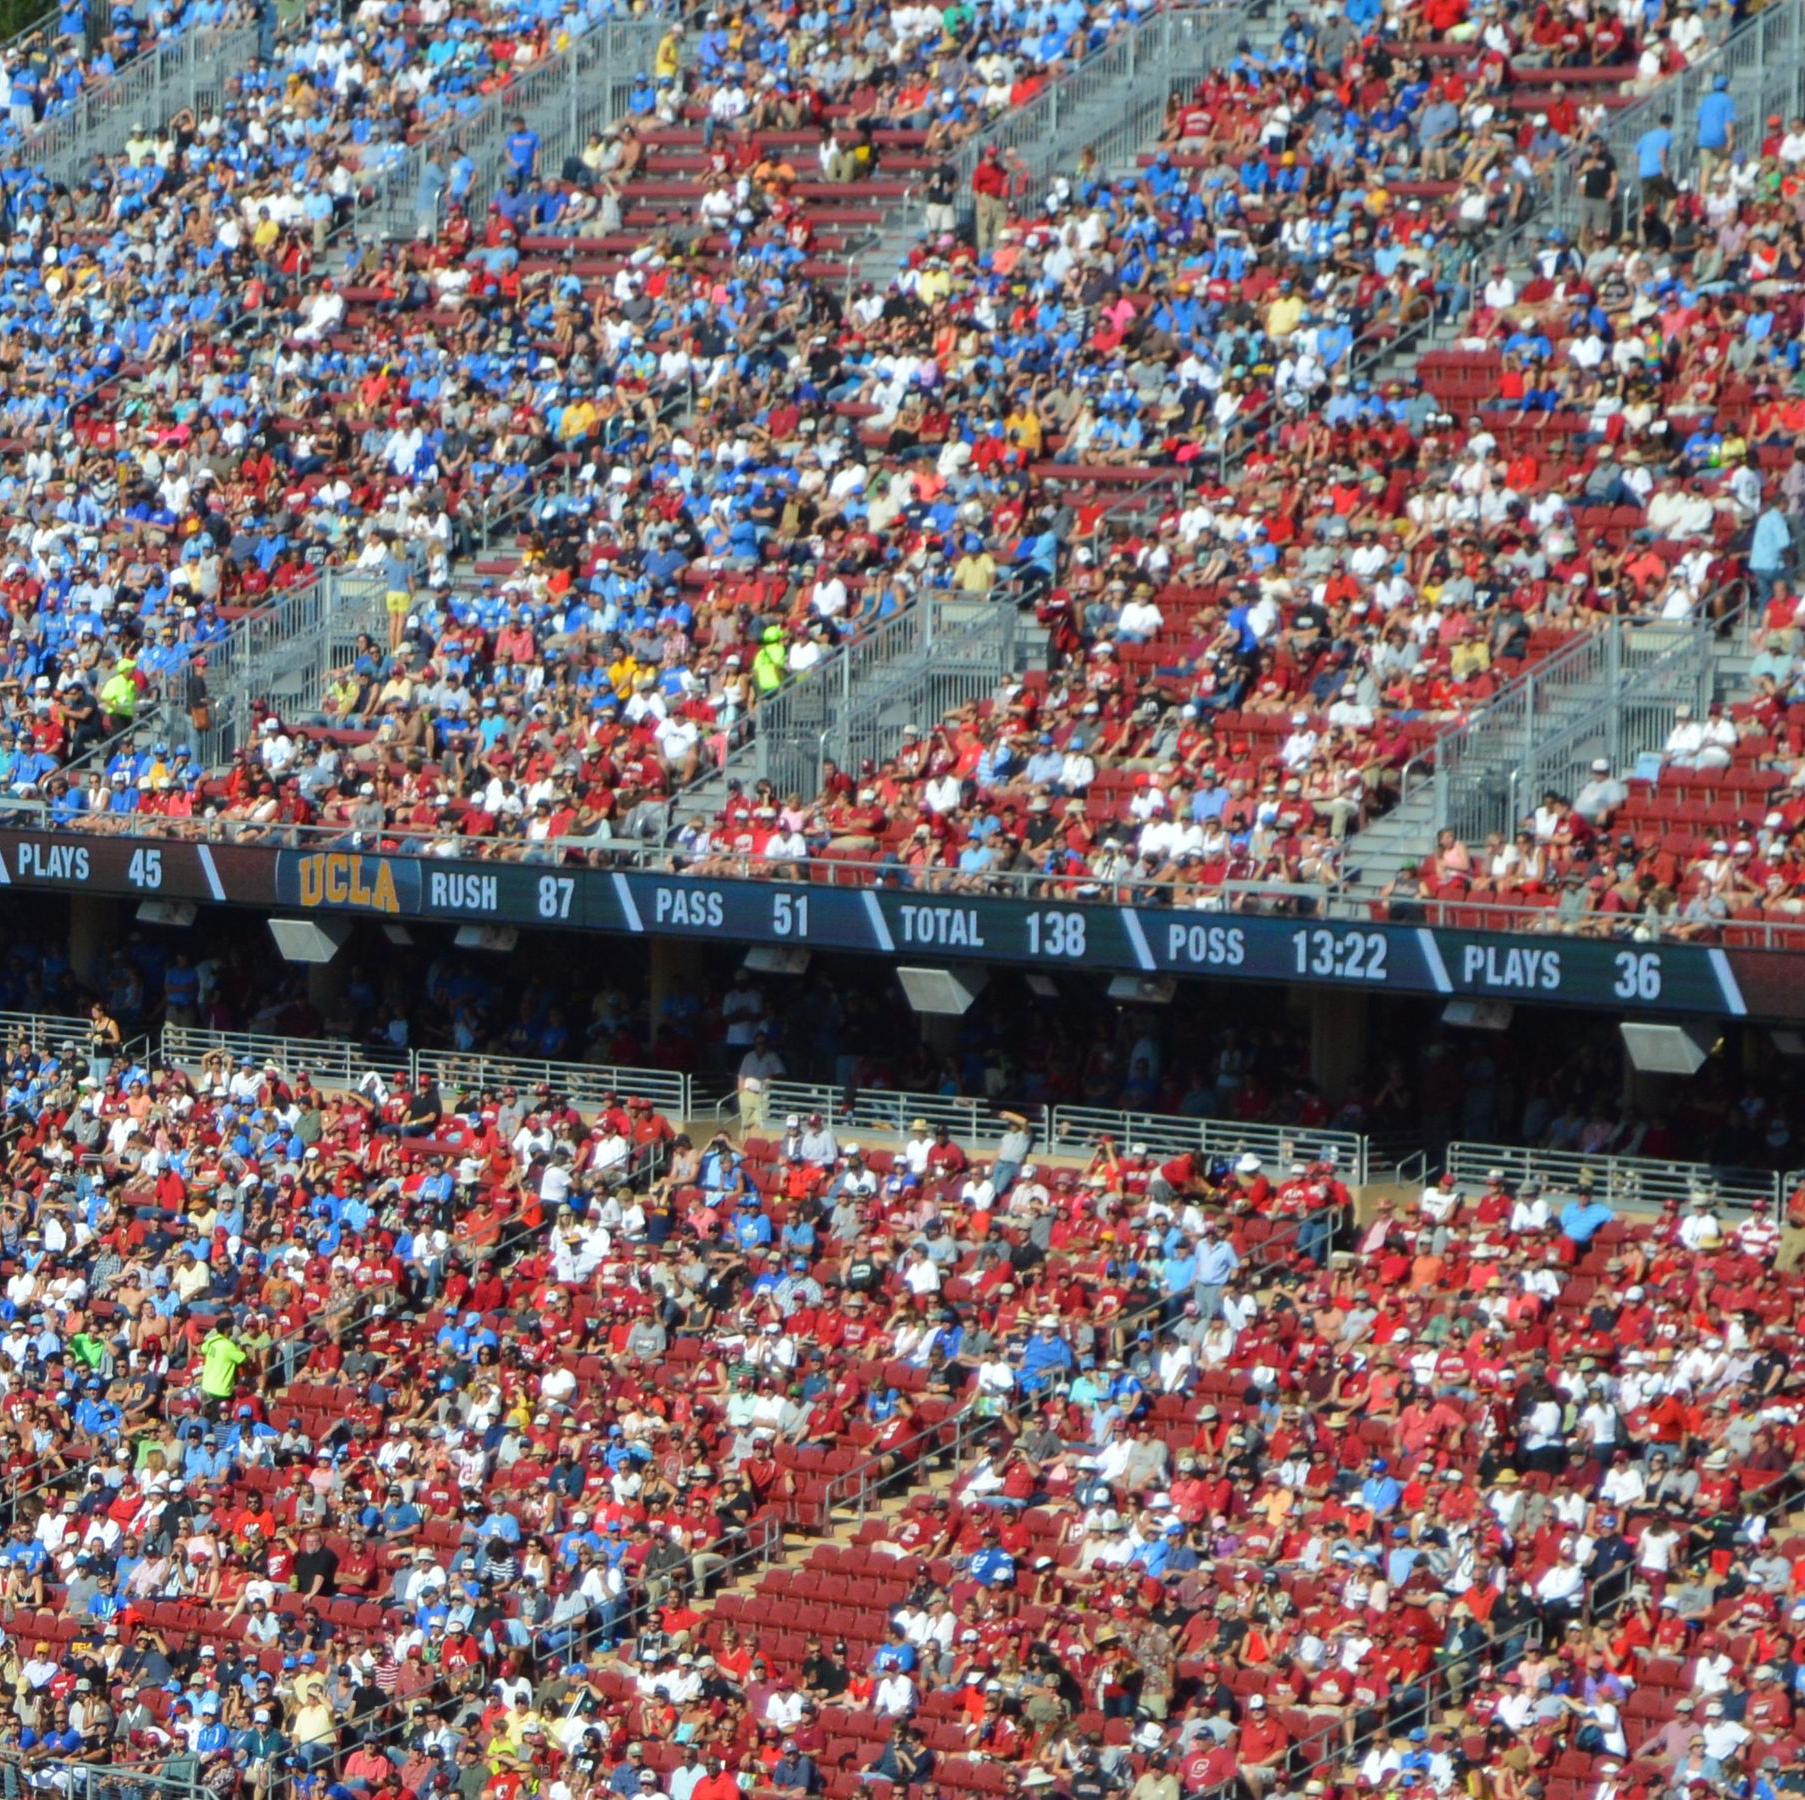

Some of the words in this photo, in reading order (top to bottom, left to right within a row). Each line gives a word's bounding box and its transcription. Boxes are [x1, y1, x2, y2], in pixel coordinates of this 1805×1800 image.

[19, 843, 88, 879] PLAYS
[129, 847, 161, 887] 45
[299, 854, 399, 912] UCLA
[432, 873, 496, 909] RUSH
[539, 876, 574, 917] 87
[657, 888, 723, 926] PASS
[774, 894, 807, 935] 51
[901, 906, 983, 945] TOTAL
[1027, 912, 1085, 956] 138
[1170, 924, 1243, 964] POSS
[1293, 930, 1386, 978] 13:22
[1465, 946, 1559, 988] PLAYS
[1615, 952, 1660, 998] 36
